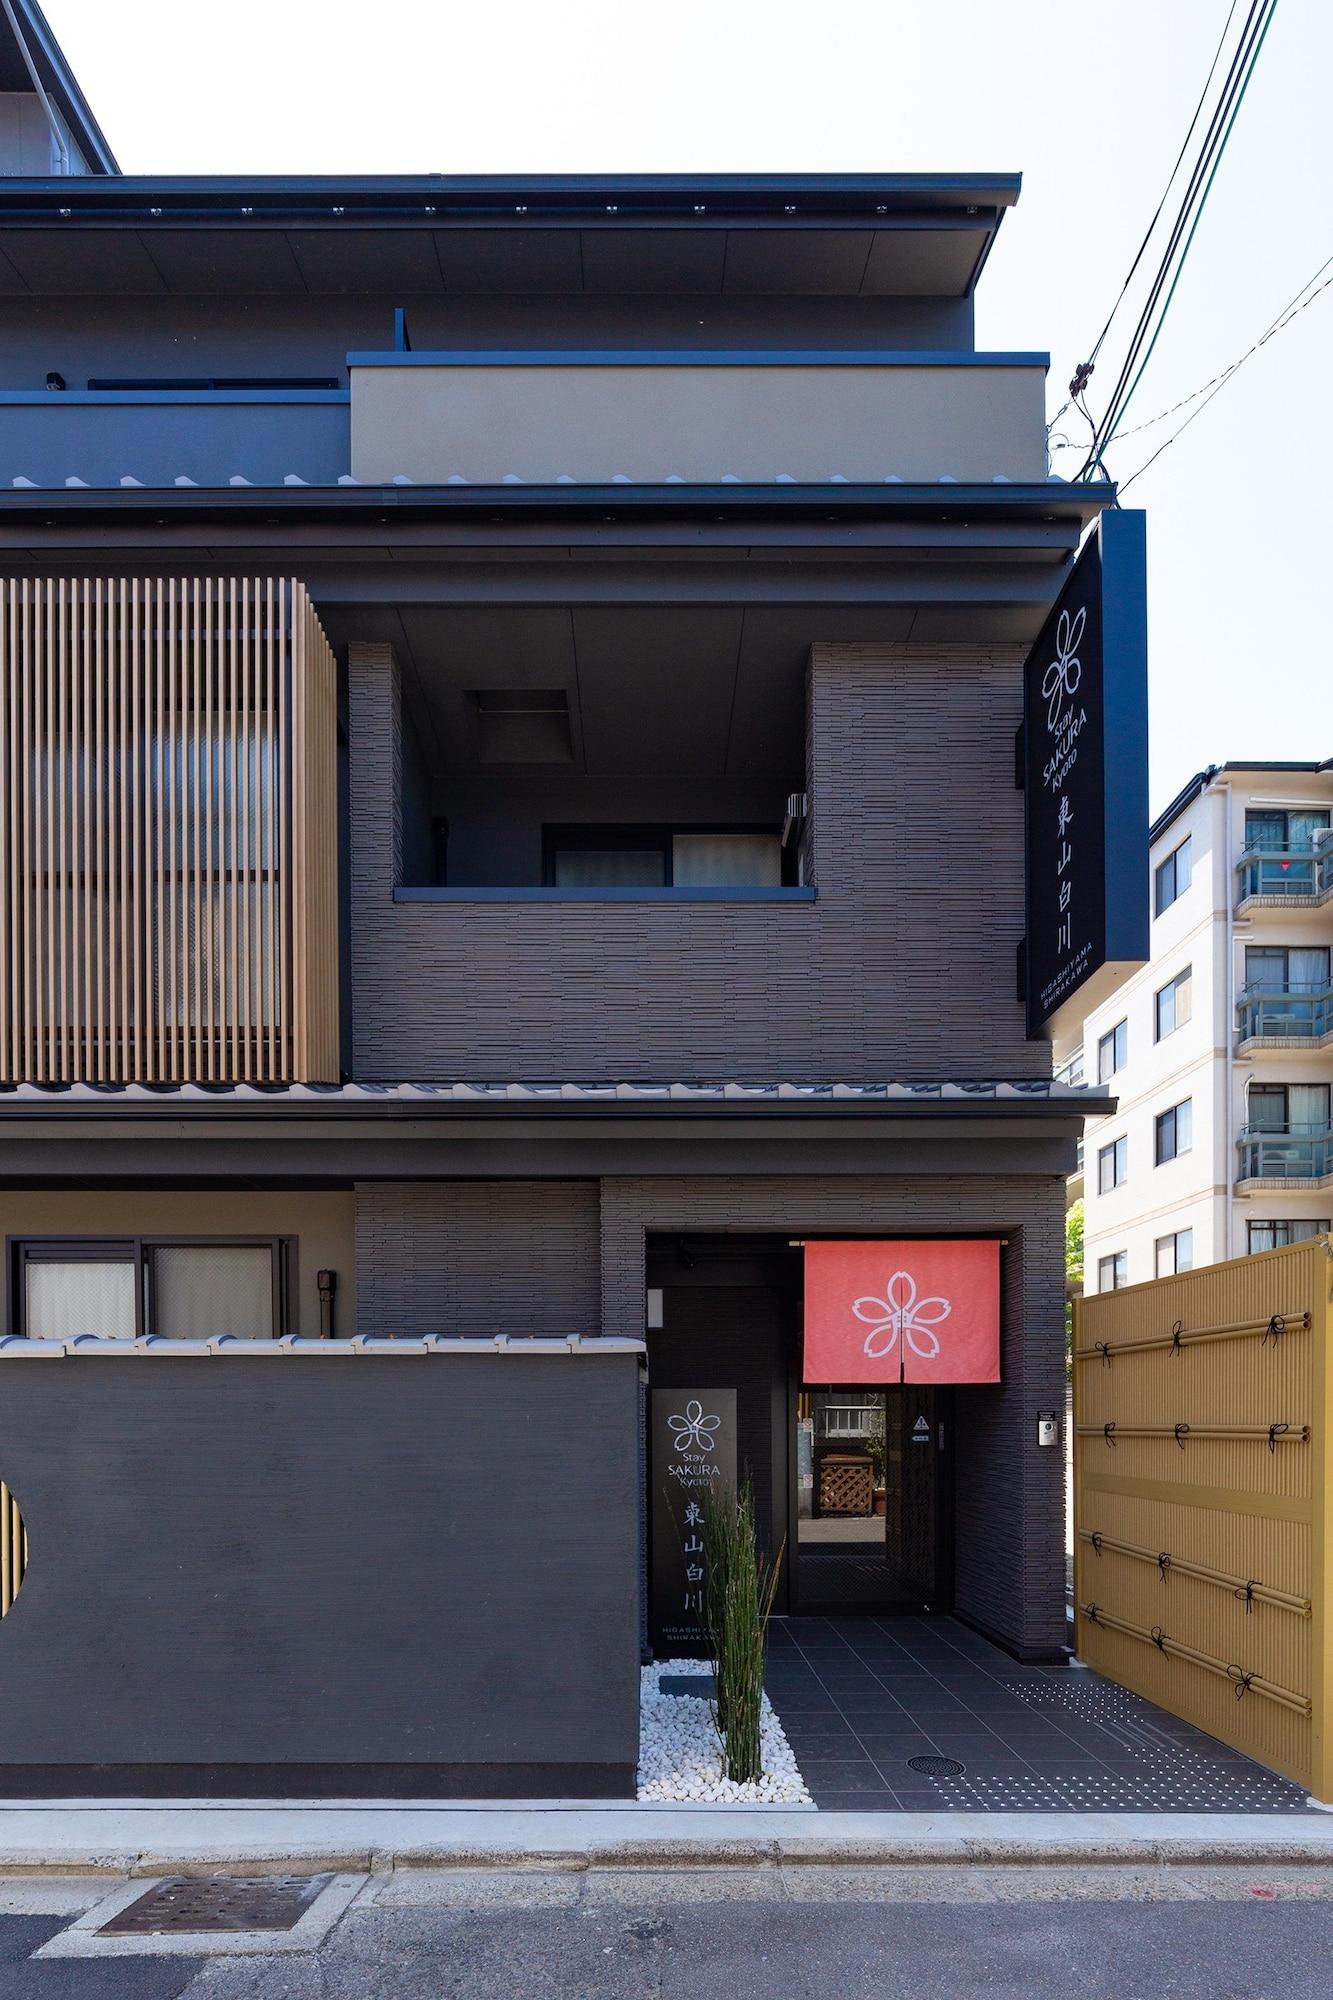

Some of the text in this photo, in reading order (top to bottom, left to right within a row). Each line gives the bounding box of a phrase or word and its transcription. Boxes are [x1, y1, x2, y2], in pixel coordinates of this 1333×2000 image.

[1054, 703, 1074, 743] Stay
[1043, 707, 1087, 787] SAKURA
[1052, 749, 1078, 793] Kyoto
[1057, 796, 1073, 954] 東山白川
[1040, 942, 1093, 1001] HIGASHIYAMA
[1043, 960, 1089, 1009] SHIRAKAWA
[668, 1464, 721, 1476] SAKURA
[682, 1452, 706, 1464] Stay
[680, 1477, 710, 1488] Kyoto
[683, 1501, 705, 1613] 東山白川
